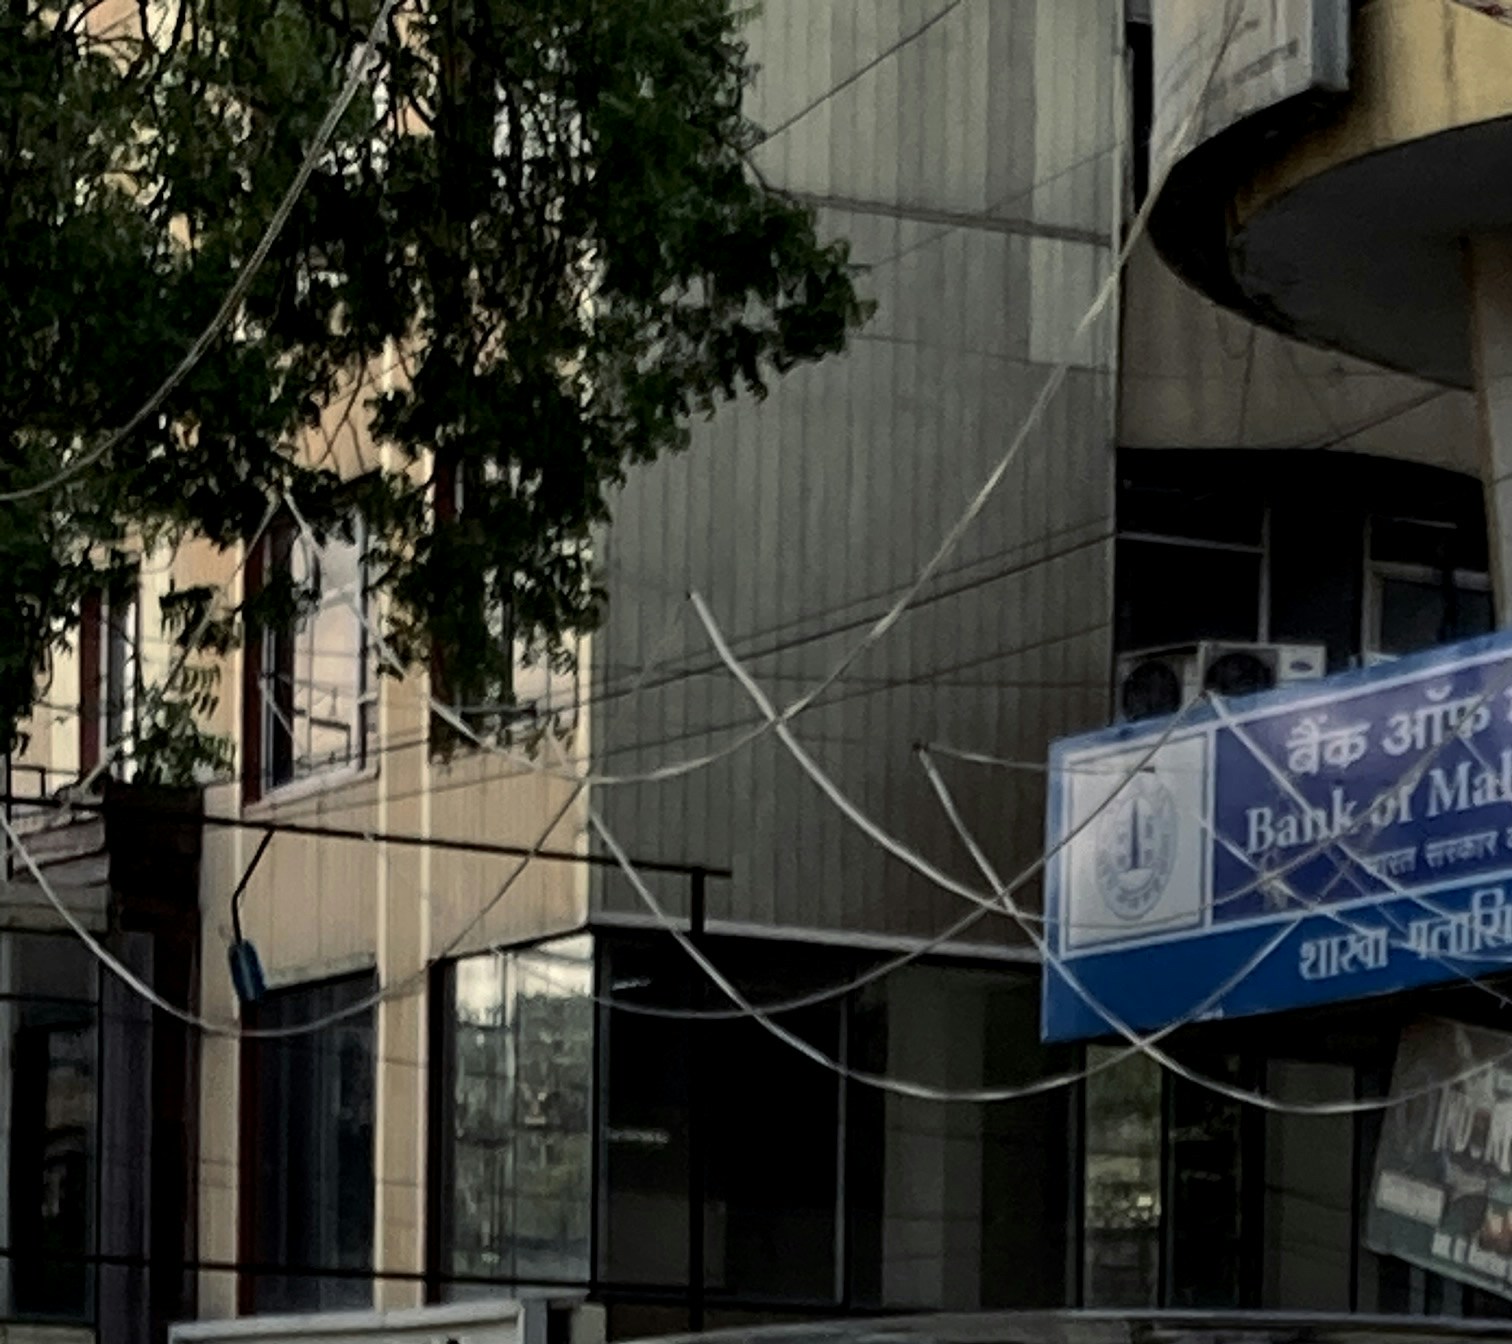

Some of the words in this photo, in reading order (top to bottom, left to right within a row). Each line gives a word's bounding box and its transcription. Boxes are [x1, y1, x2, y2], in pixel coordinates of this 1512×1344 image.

[1286, 713, 1372, 775] बैंक
[1381, 684, 1491, 755] ऑफ
[1245, 785, 1357, 853] Bank
[1369, 782, 1418, 828] of
[1299, 923, 1389, 981] शाखा
